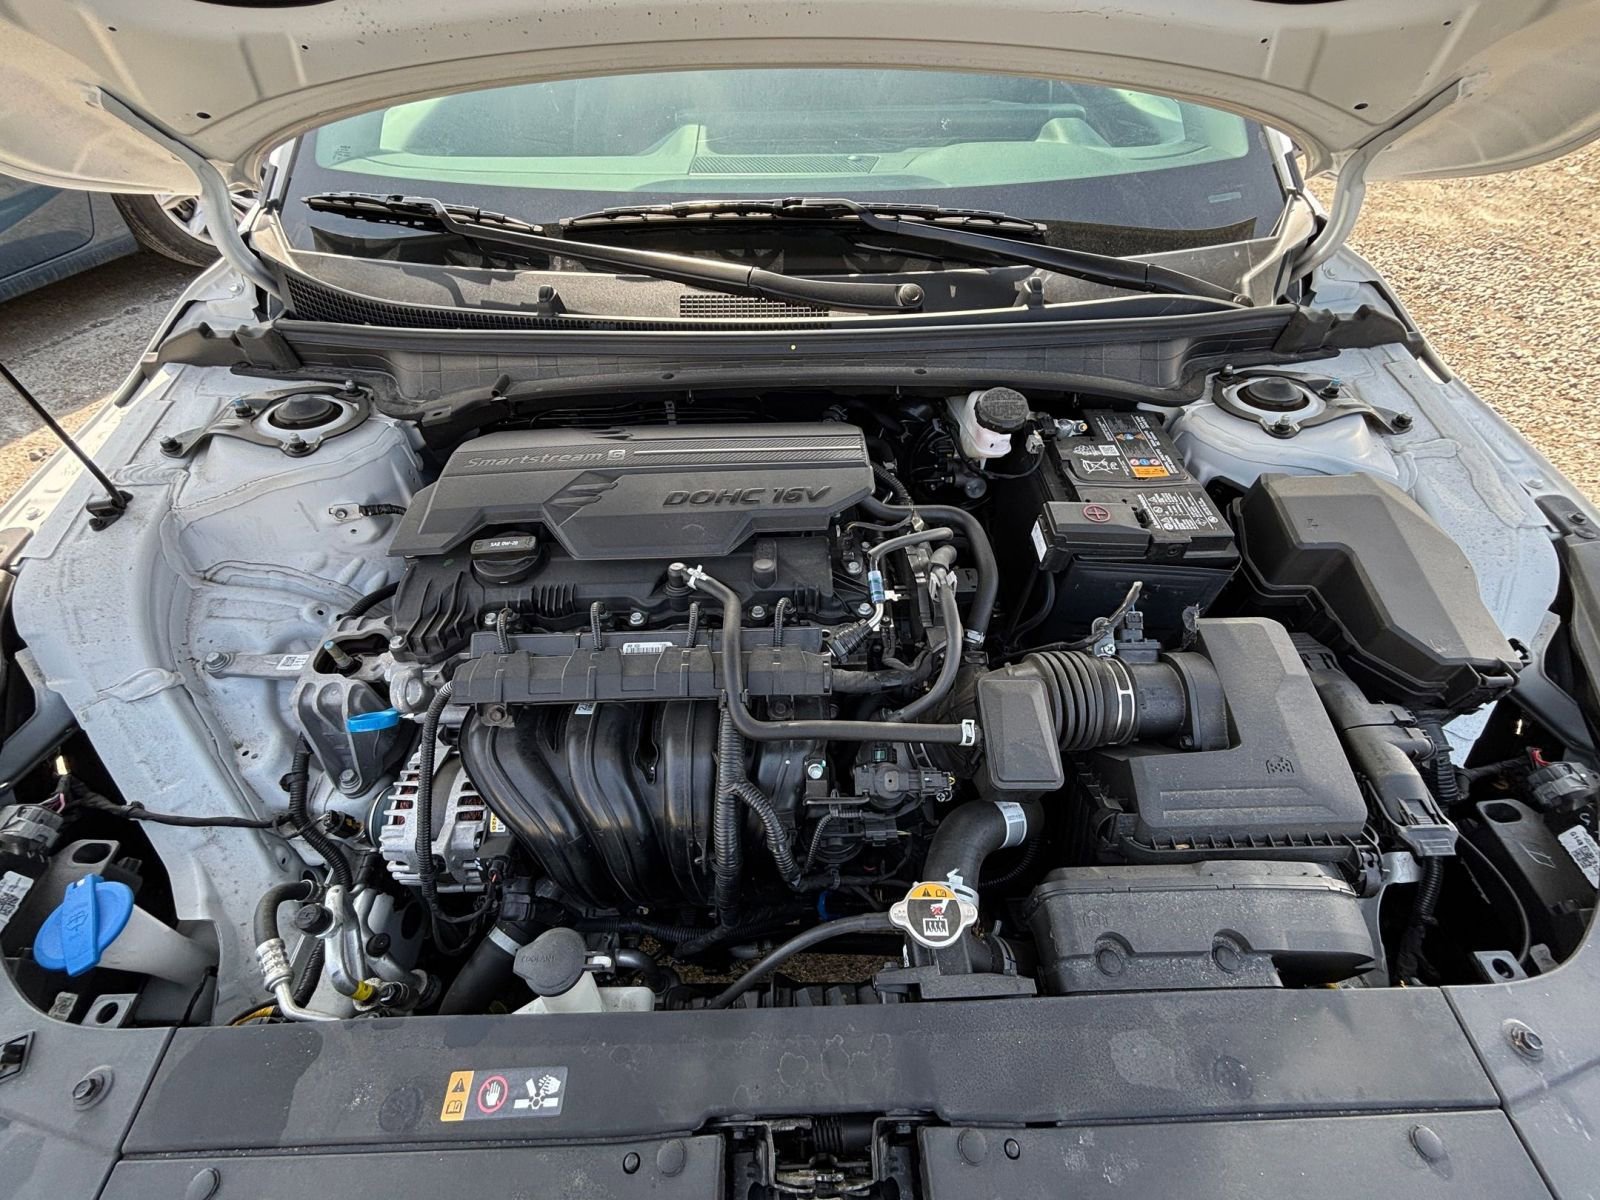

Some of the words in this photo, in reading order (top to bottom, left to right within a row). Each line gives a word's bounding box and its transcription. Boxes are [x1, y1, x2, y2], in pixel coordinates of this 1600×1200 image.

[464, 452, 603, 468] Smartstream
[662, 488, 766, 506] DOHC
[772, 485, 832, 504] 16V
